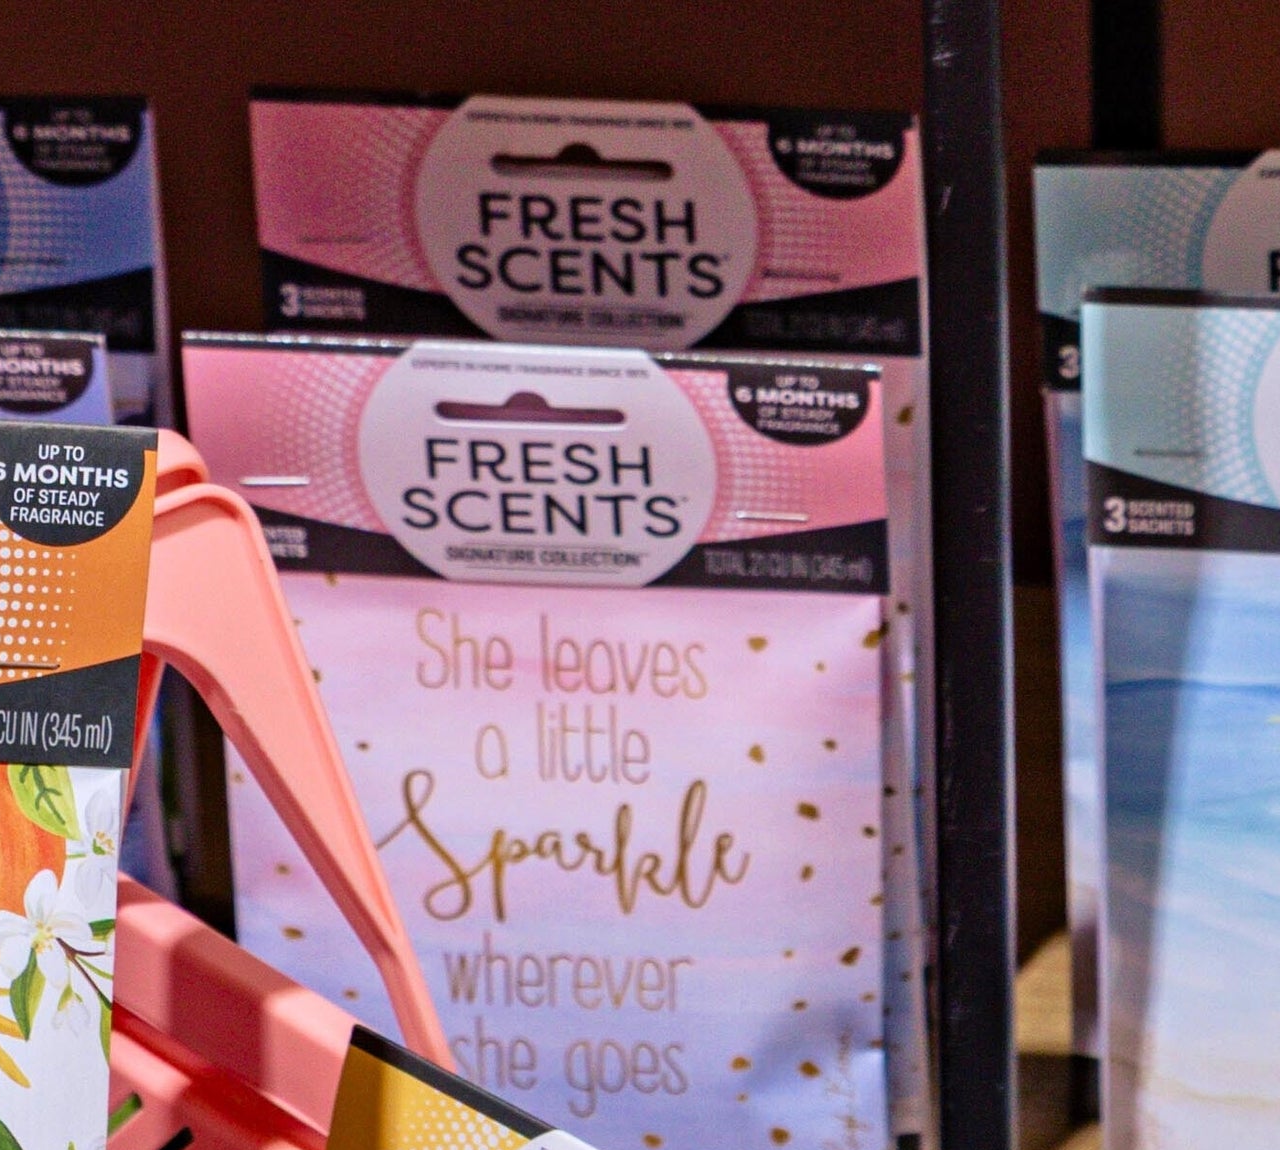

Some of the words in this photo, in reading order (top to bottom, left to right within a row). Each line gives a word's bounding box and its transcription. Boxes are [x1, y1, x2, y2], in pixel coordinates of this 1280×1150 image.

[796, 141, 894, 160] MONTHS
[479, 192, 696, 245] FRESH
[456, 243, 724, 298] SCENTS
[280, 283, 298, 317] 3
[735, 385, 753, 403] 6
[755, 387, 861, 410] MONTHS
[13, 463, 130, 489] MONTHS
[38, 444, 60, 461] UP
[63, 445, 84, 462] TO
[425, 437, 653, 487] FRESH
[9, 507, 105, 527] FRAGRANCE
[13, 487, 34, 503] OF
[37, 489, 100, 508] STEADY
[401, 487, 683, 538] SCENTS
[1104, 496, 1125, 533] 3
[415, 606, 515, 691] She
[538, 613, 708, 700] leaves
[21, 711, 38, 746] IN
[41, 712, 82, 752] (345
[84, 715, 113, 754] ml)
[475, 724, 509, 779] a
[536, 698, 651, 785] little
[376, 769, 751, 924] Sparkle
[443, 929, 694, 1012] wherever
[564, 1037, 690, 1119] goes
